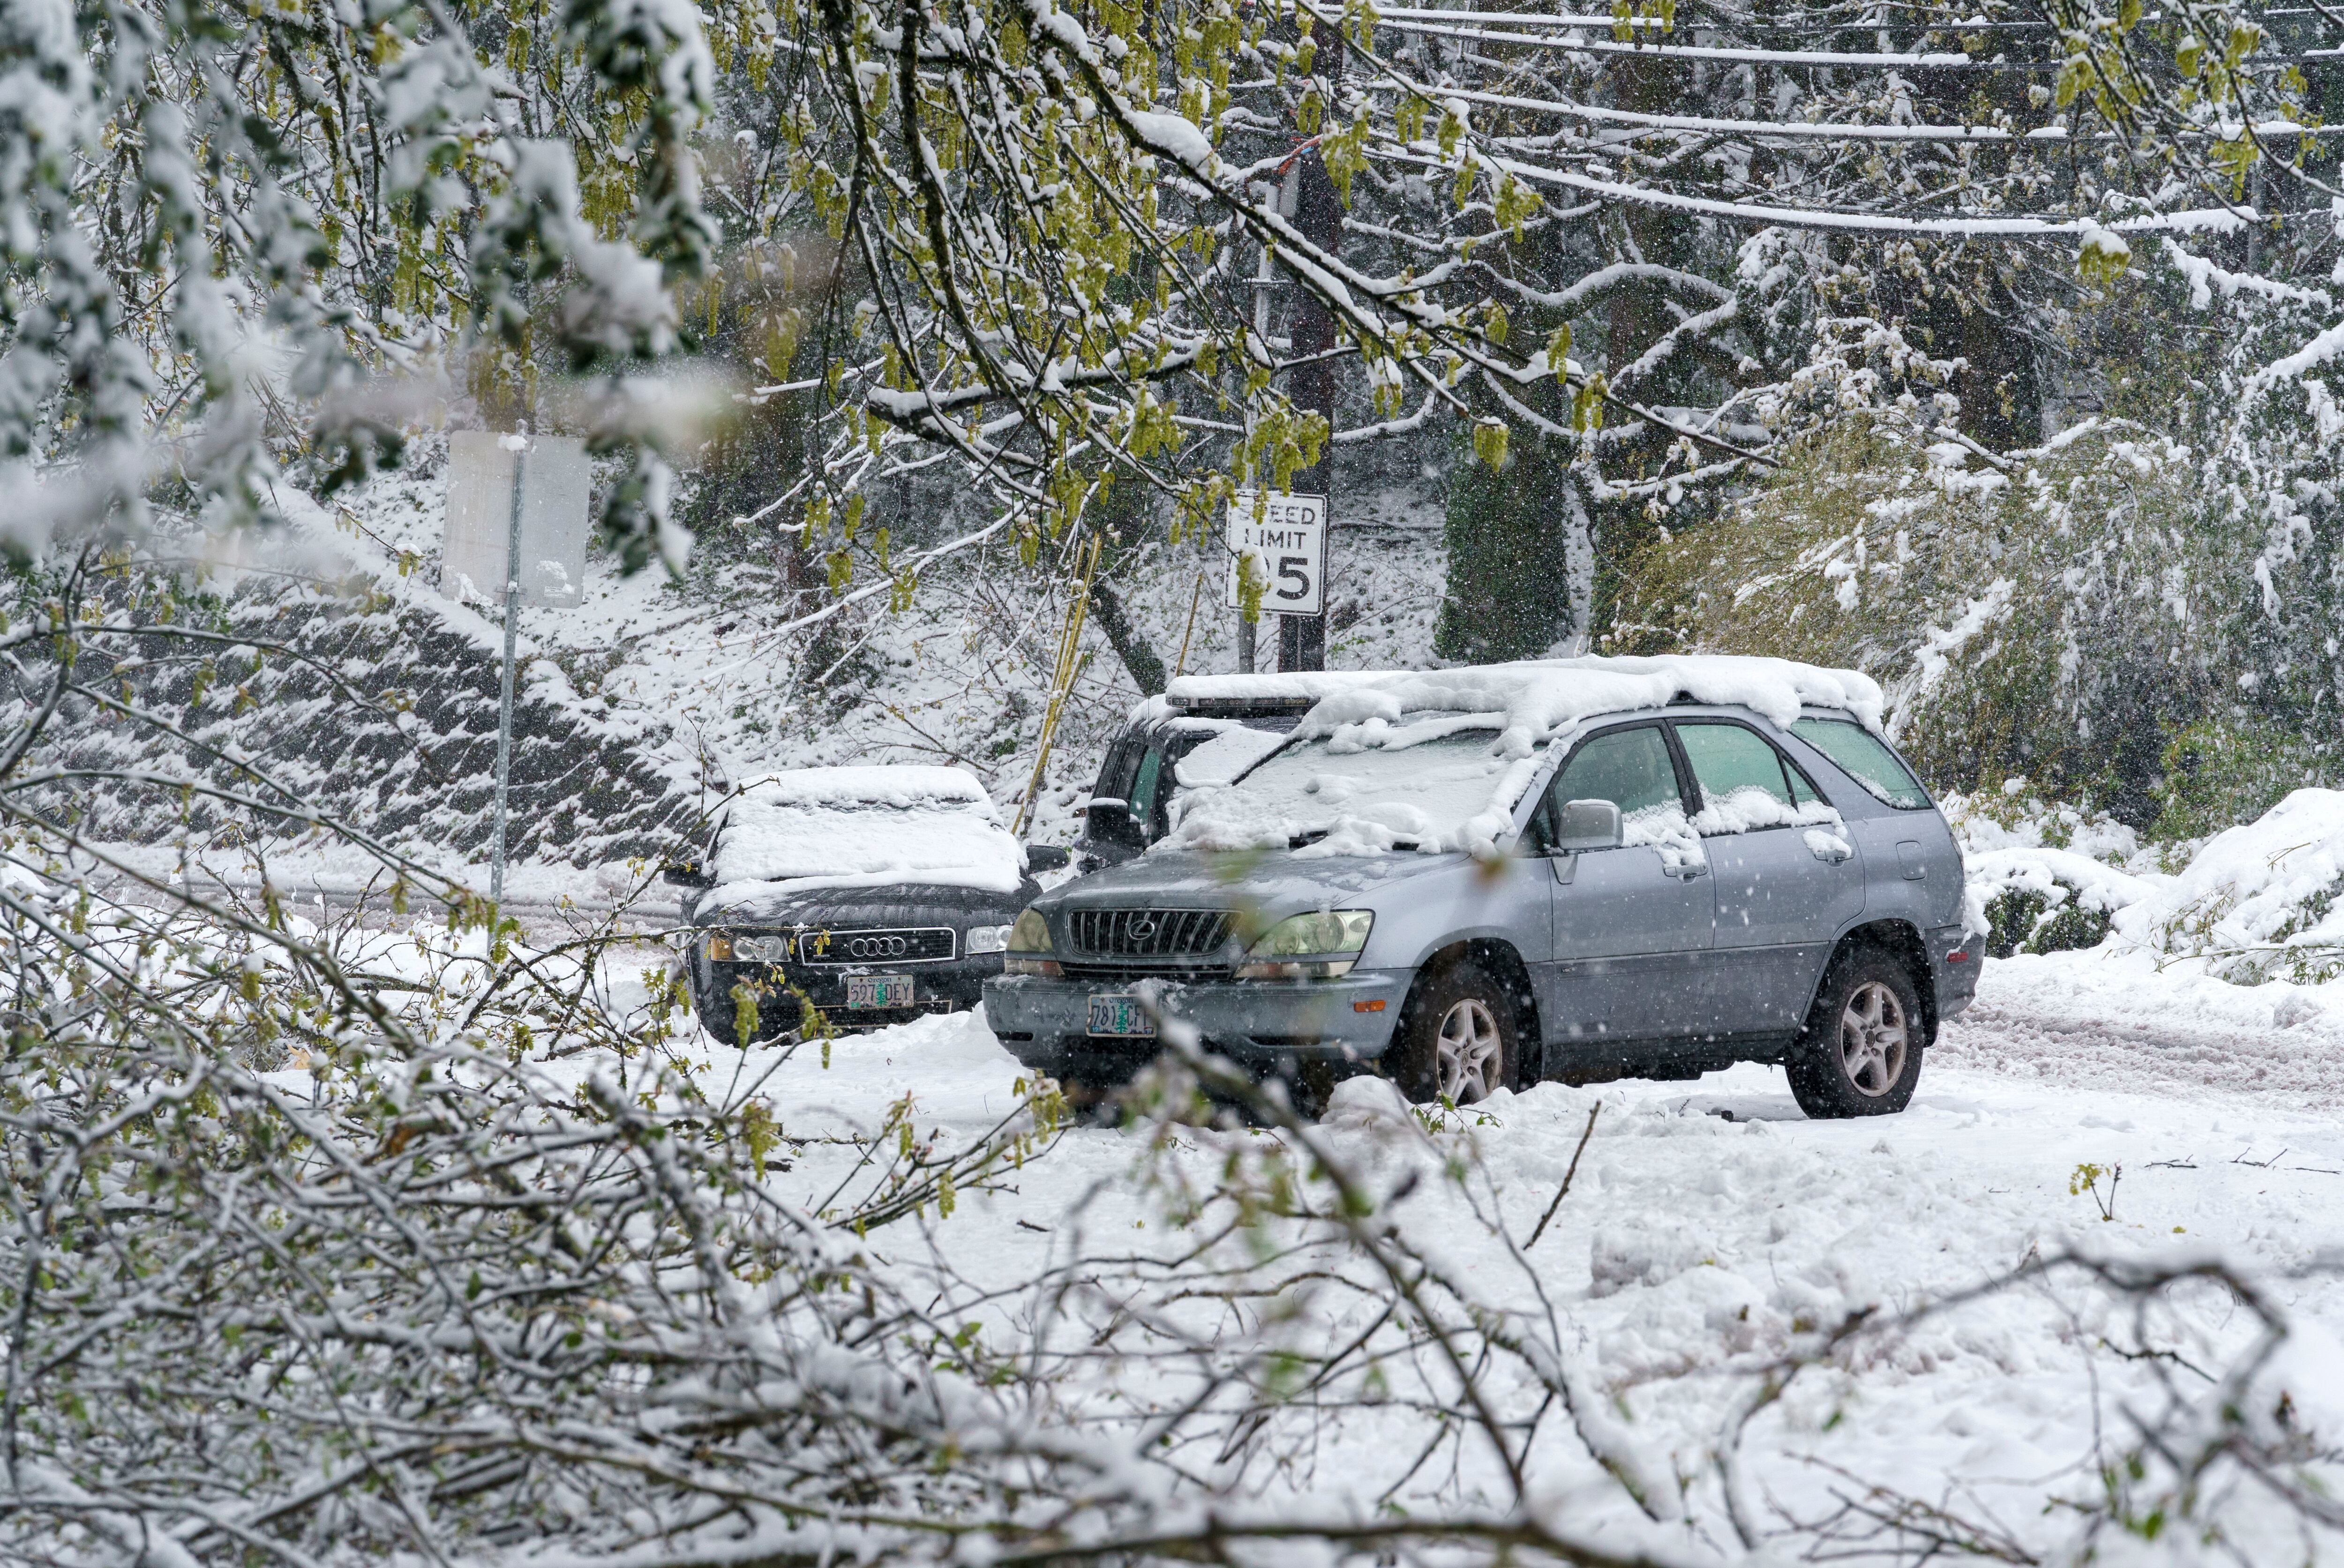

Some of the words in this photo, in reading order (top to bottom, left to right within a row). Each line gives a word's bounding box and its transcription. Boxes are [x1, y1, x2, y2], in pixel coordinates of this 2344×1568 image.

[1239, 503, 1316, 525] EED
[851, 984, 875, 1001] 597
[885, 983, 909, 1001] DEY
[1093, 1005, 1116, 1026] 781
